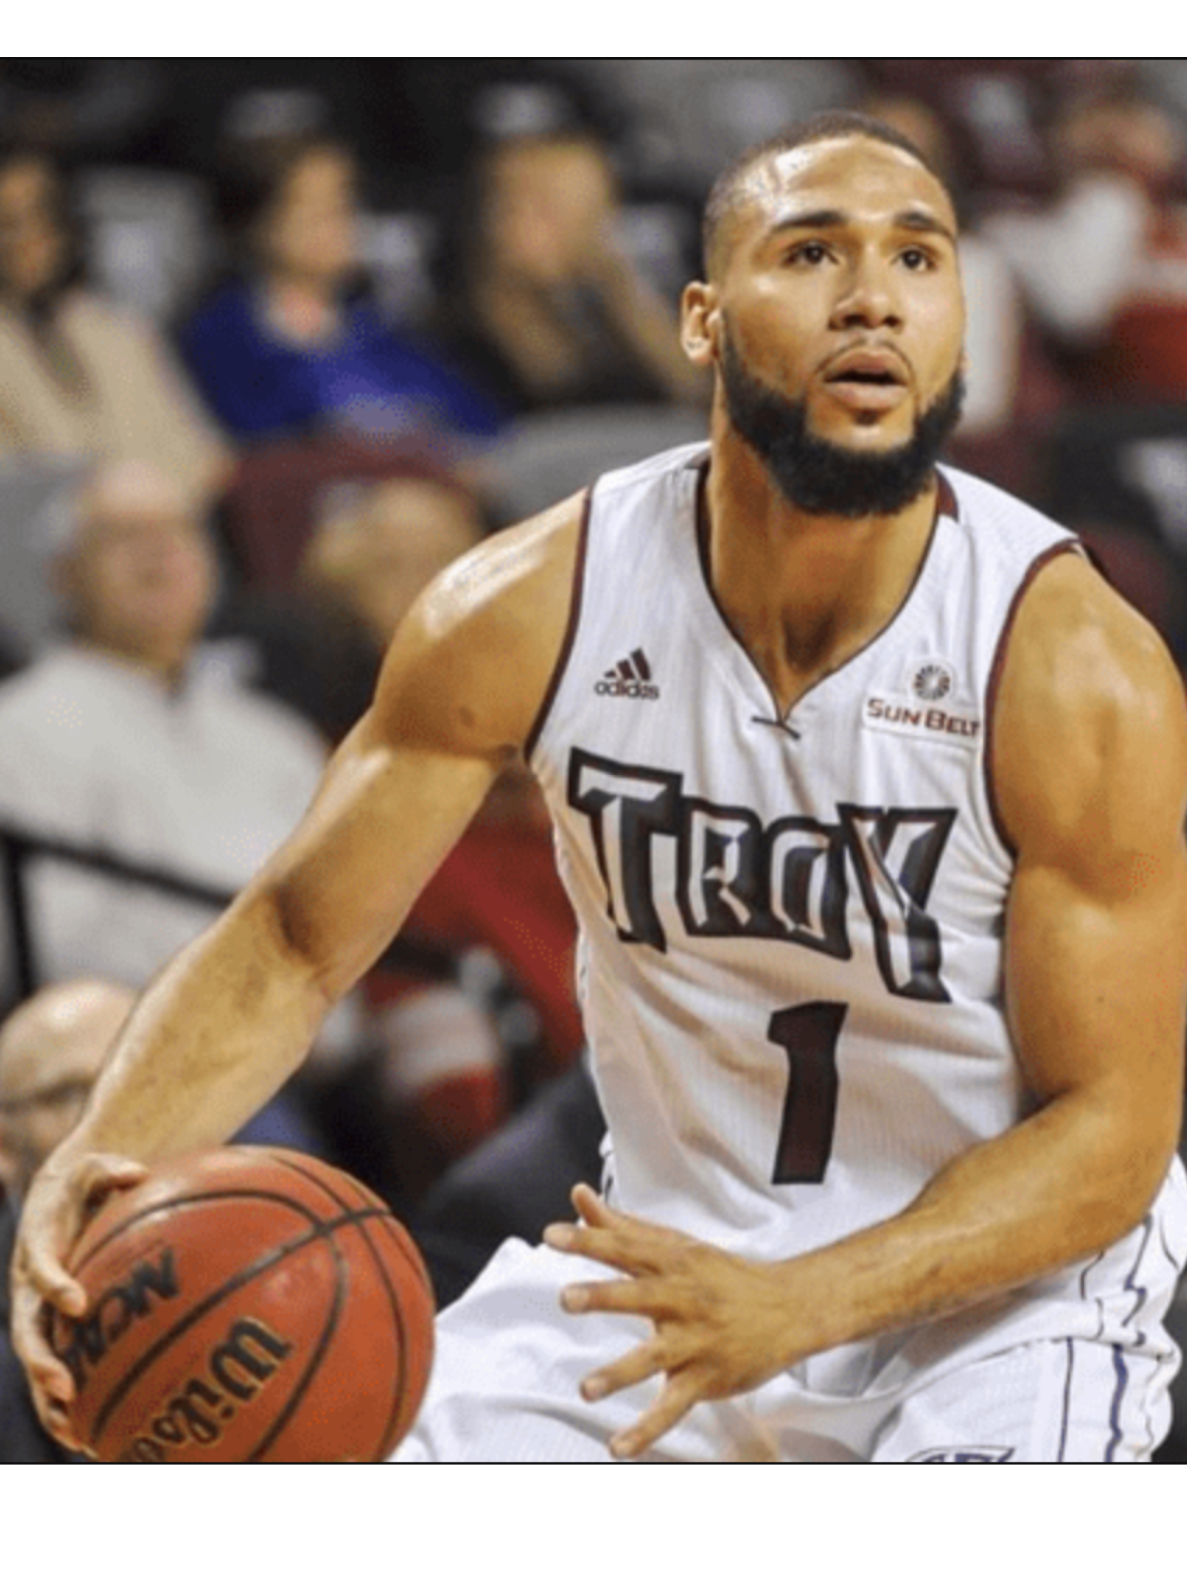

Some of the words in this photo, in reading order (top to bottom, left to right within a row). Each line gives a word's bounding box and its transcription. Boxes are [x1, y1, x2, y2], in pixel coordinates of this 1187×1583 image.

[594, 680, 660, 701] adidas
[568, 746, 959, 1003] TROY
[767, 1001, 850, 1186] 1
[121, 1315, 295, 1462] Wilso
